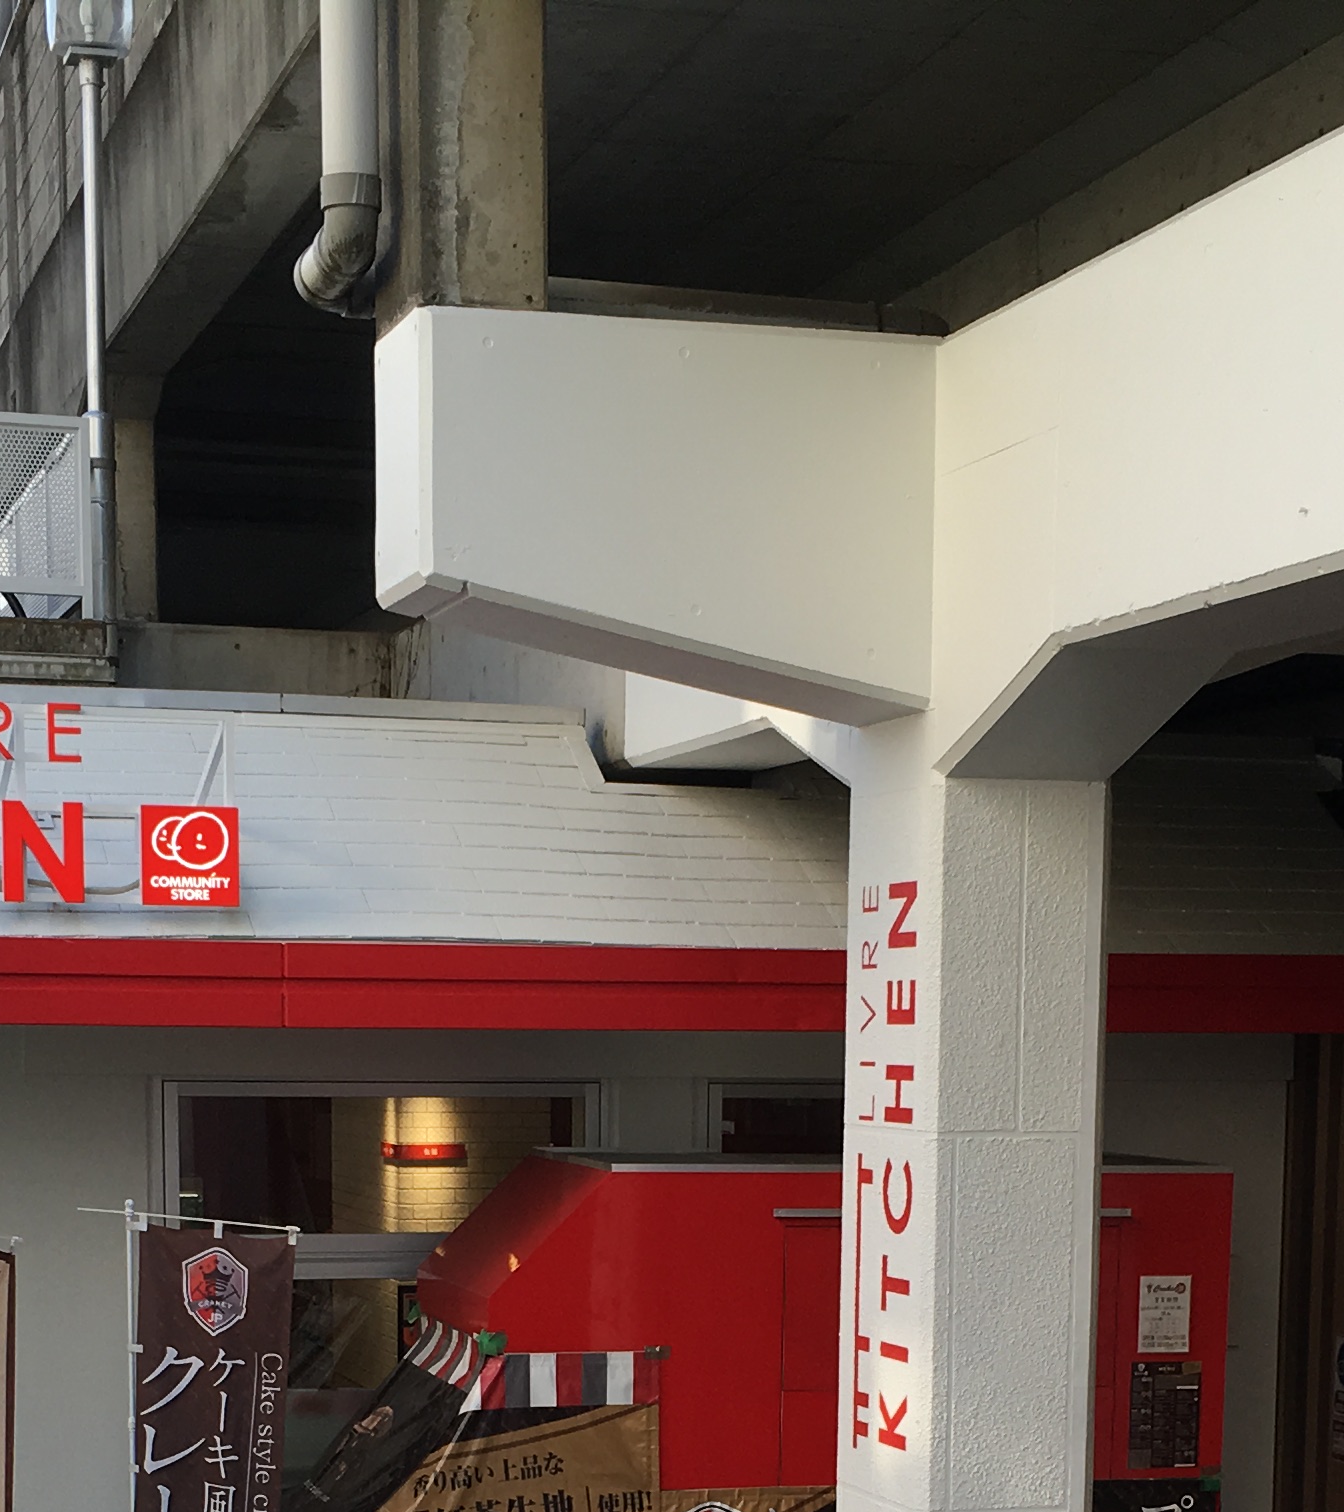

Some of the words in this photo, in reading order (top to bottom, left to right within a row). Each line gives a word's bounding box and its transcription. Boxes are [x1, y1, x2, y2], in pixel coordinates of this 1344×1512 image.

[170, 888, 211, 901] STORE
[858, 884, 879, 1121] LIVRE
[877, 880, 919, 1451] KITCHEN
[207, 1311, 224, 1324] JP
[259, 1352, 284, 1415] Cake
[253, 1423, 278, 1484] style
[413, 1452, 565, 1498] 香り高い上品な
